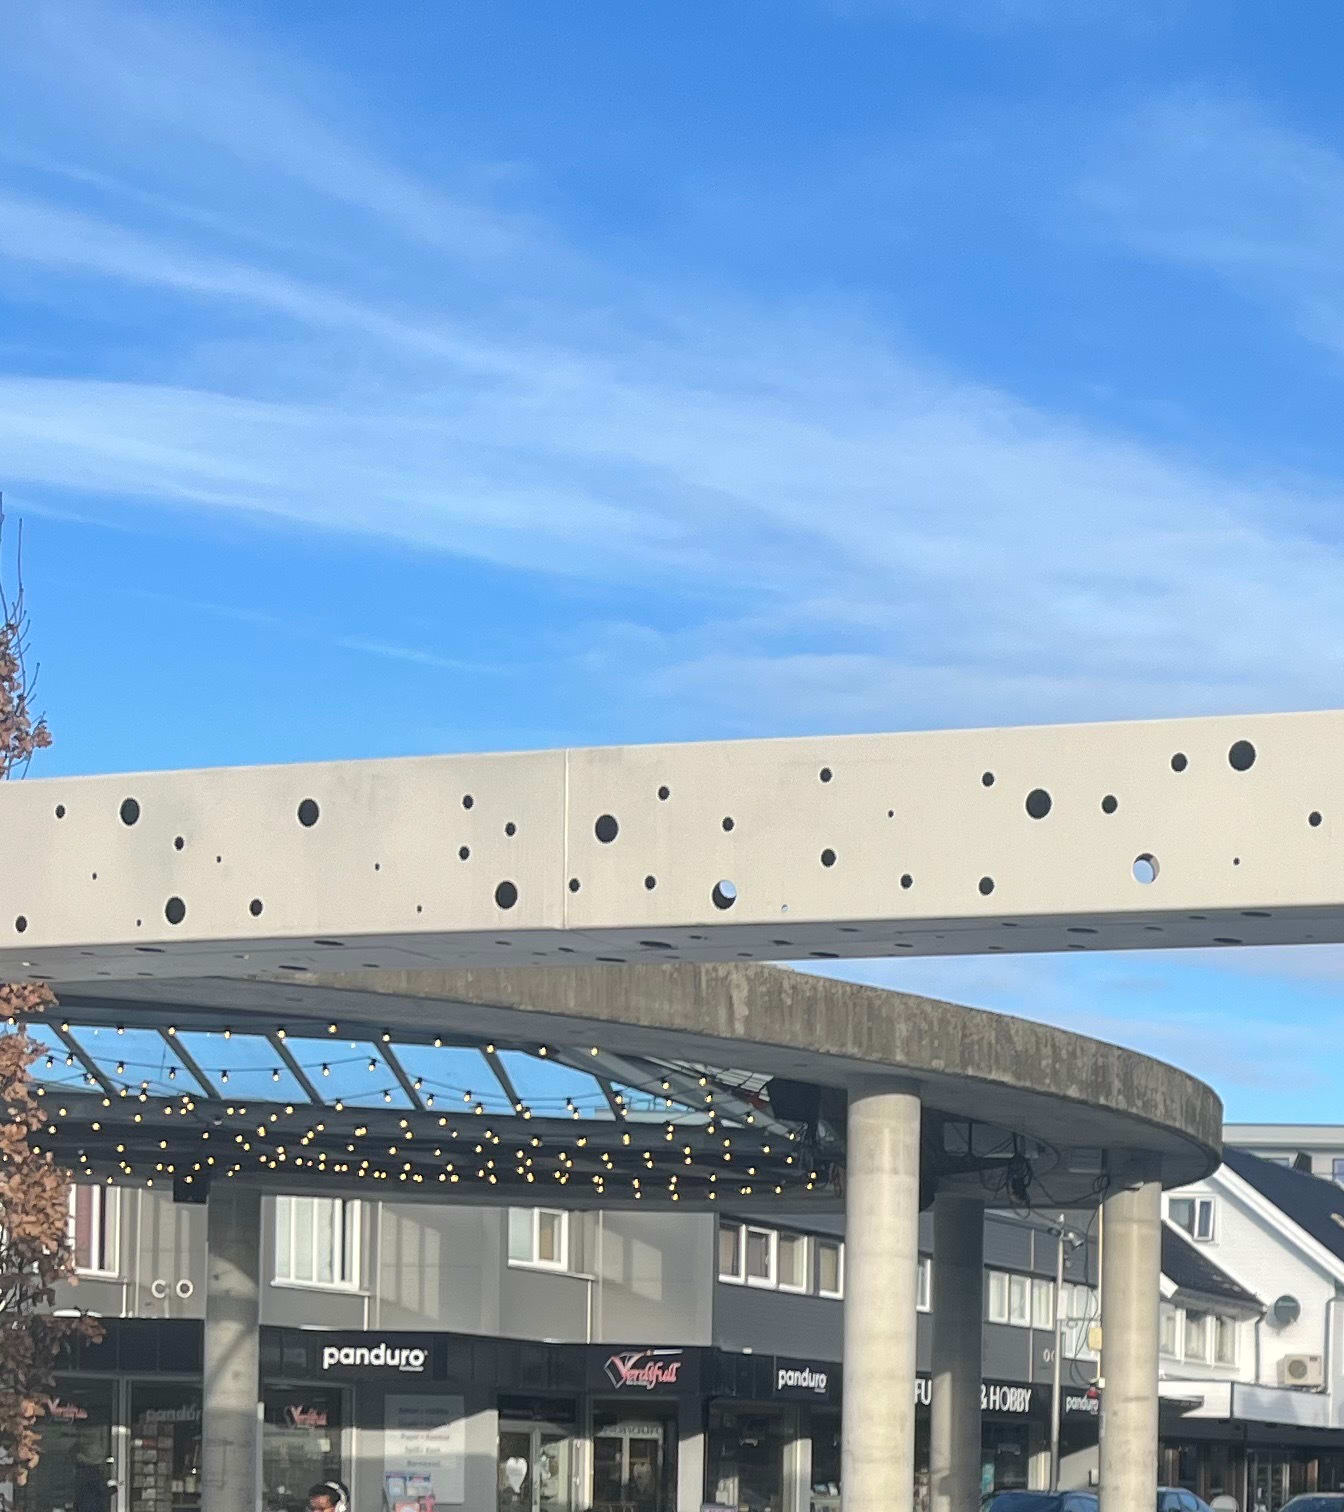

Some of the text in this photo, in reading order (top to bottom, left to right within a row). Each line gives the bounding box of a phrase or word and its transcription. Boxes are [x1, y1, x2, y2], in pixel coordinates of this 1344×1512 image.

[322, 1342, 426, 1370] panduro
[777, 1367, 827, 1390] panduro
[990, 1385, 1032, 1413] HOBBY
